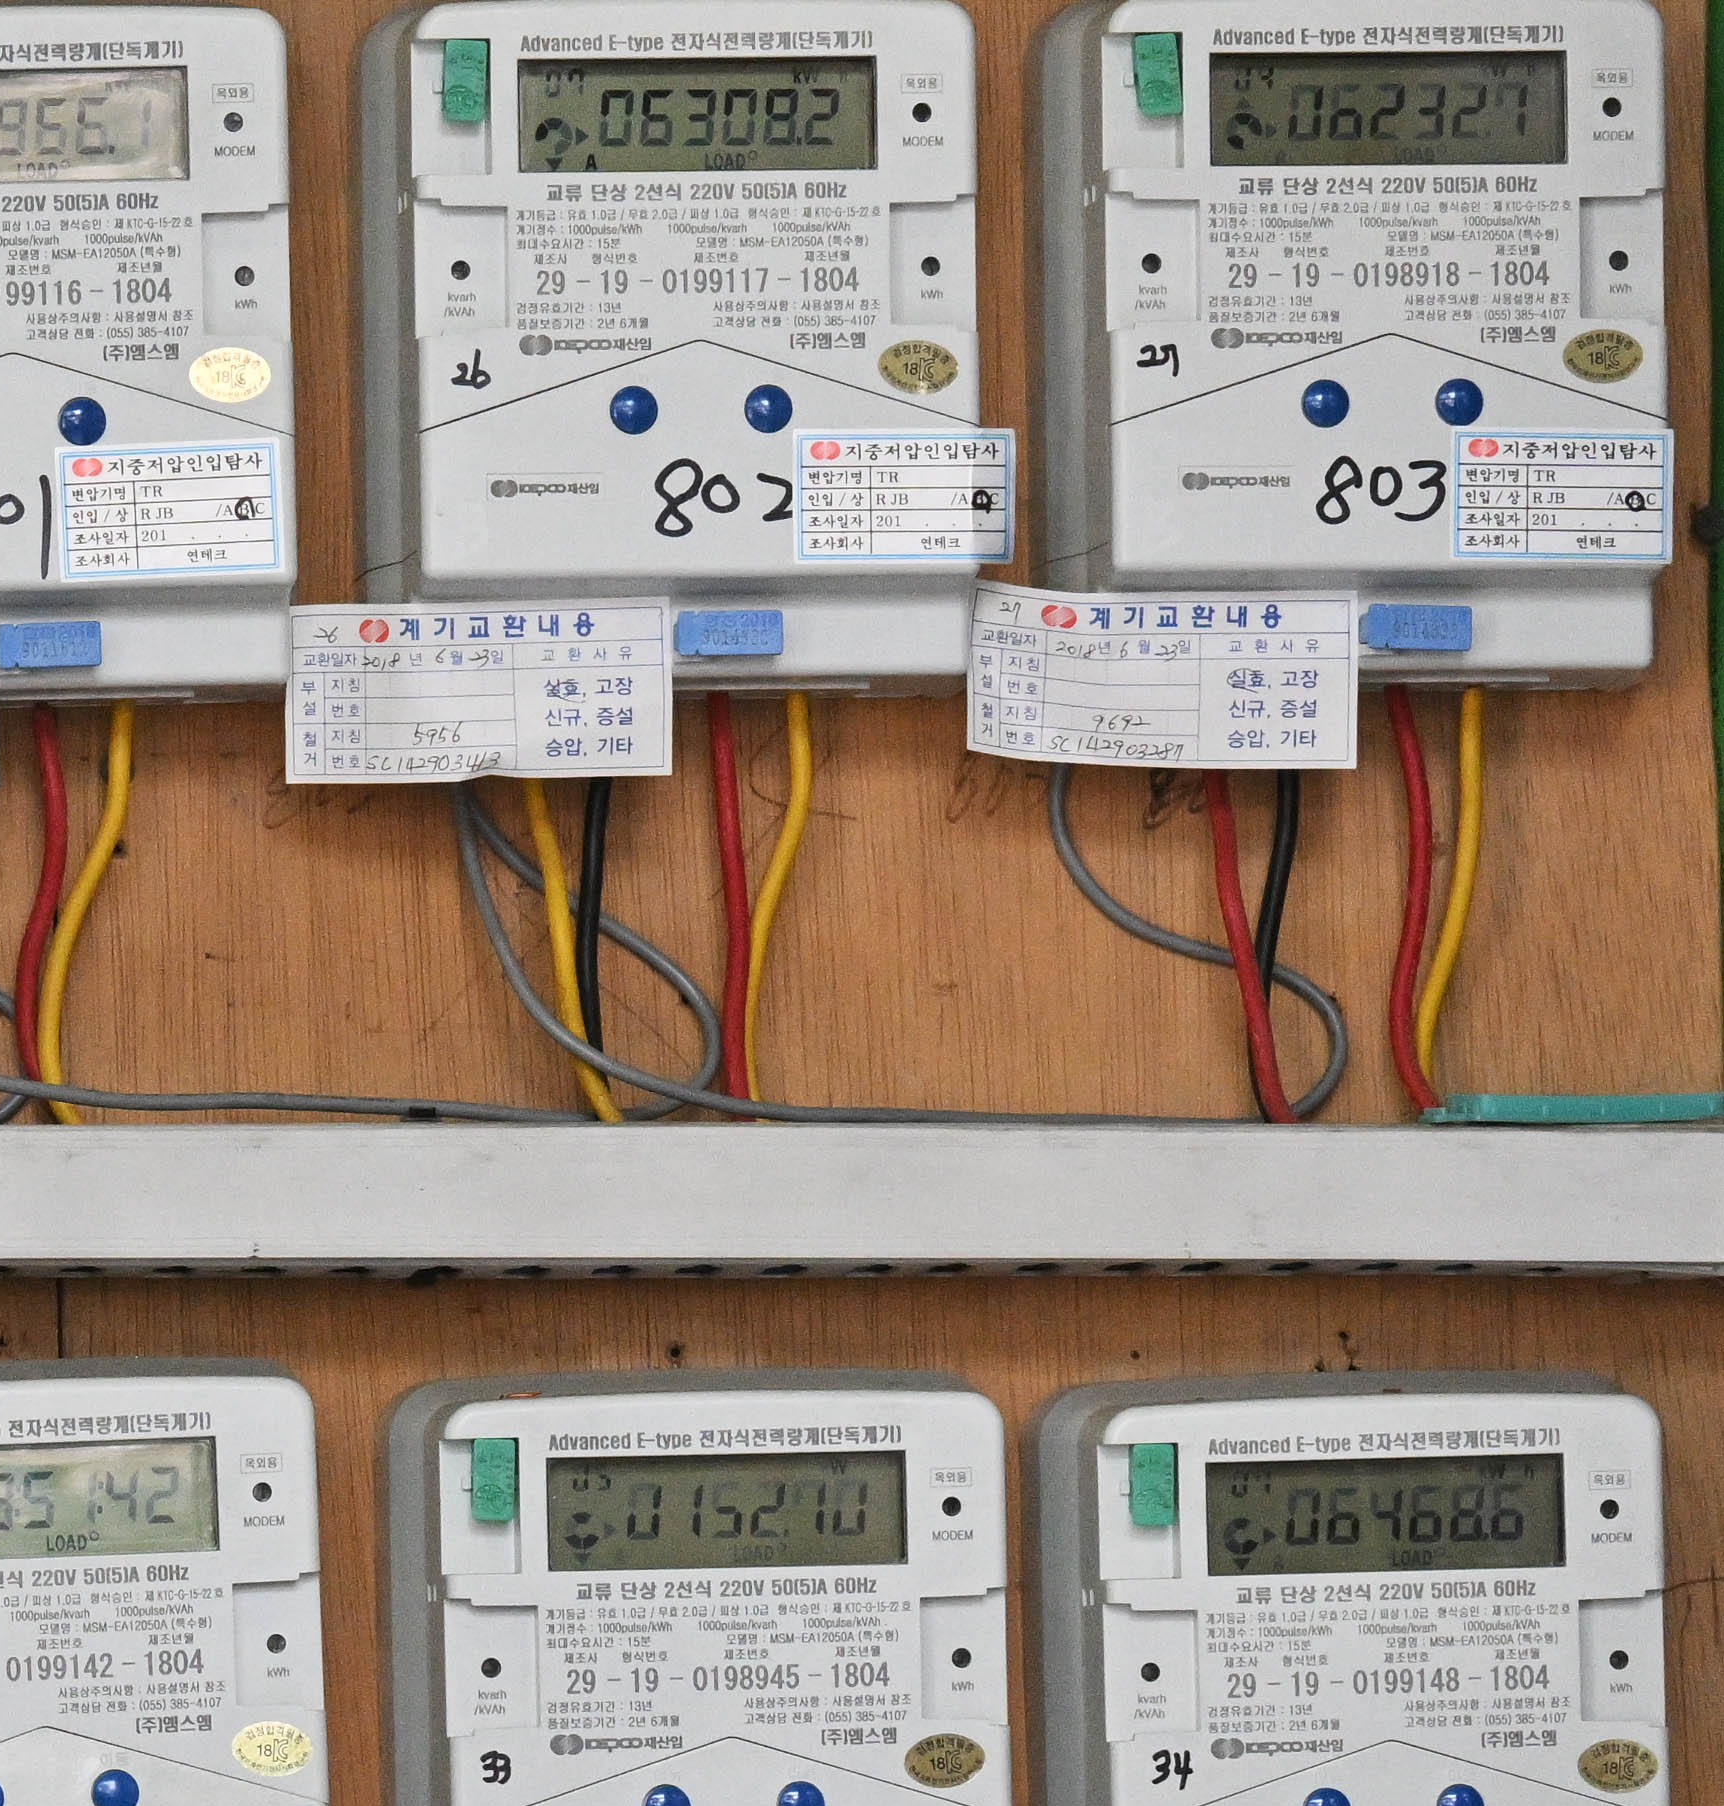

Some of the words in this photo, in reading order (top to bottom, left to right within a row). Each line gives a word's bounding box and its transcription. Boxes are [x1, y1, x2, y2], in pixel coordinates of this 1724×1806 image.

[536, 270, 566, 295] 29
[600, 269, 629, 295] 19
[662, 267, 769, 294] 0199117
[800, 266, 859, 292] 1804
[1353, 261, 1460, 288] 0198918
[1484, 309, 1511, 321] (055)
[1515, 309, 1565, 320] 385-4107
[654, 458, 793, 537] 802
[1315, 455, 1448, 525] 803
[548, 1433, 631, 1451] Advanced
[637, 1431, 691, 1450] E-type
[6, 1652, 113, 1682] 0199142
[144, 1648, 204, 1676] 1804
[693, 1664, 800, 1692] 0198945
[1353, 1667, 1460, 1695] 0199148
